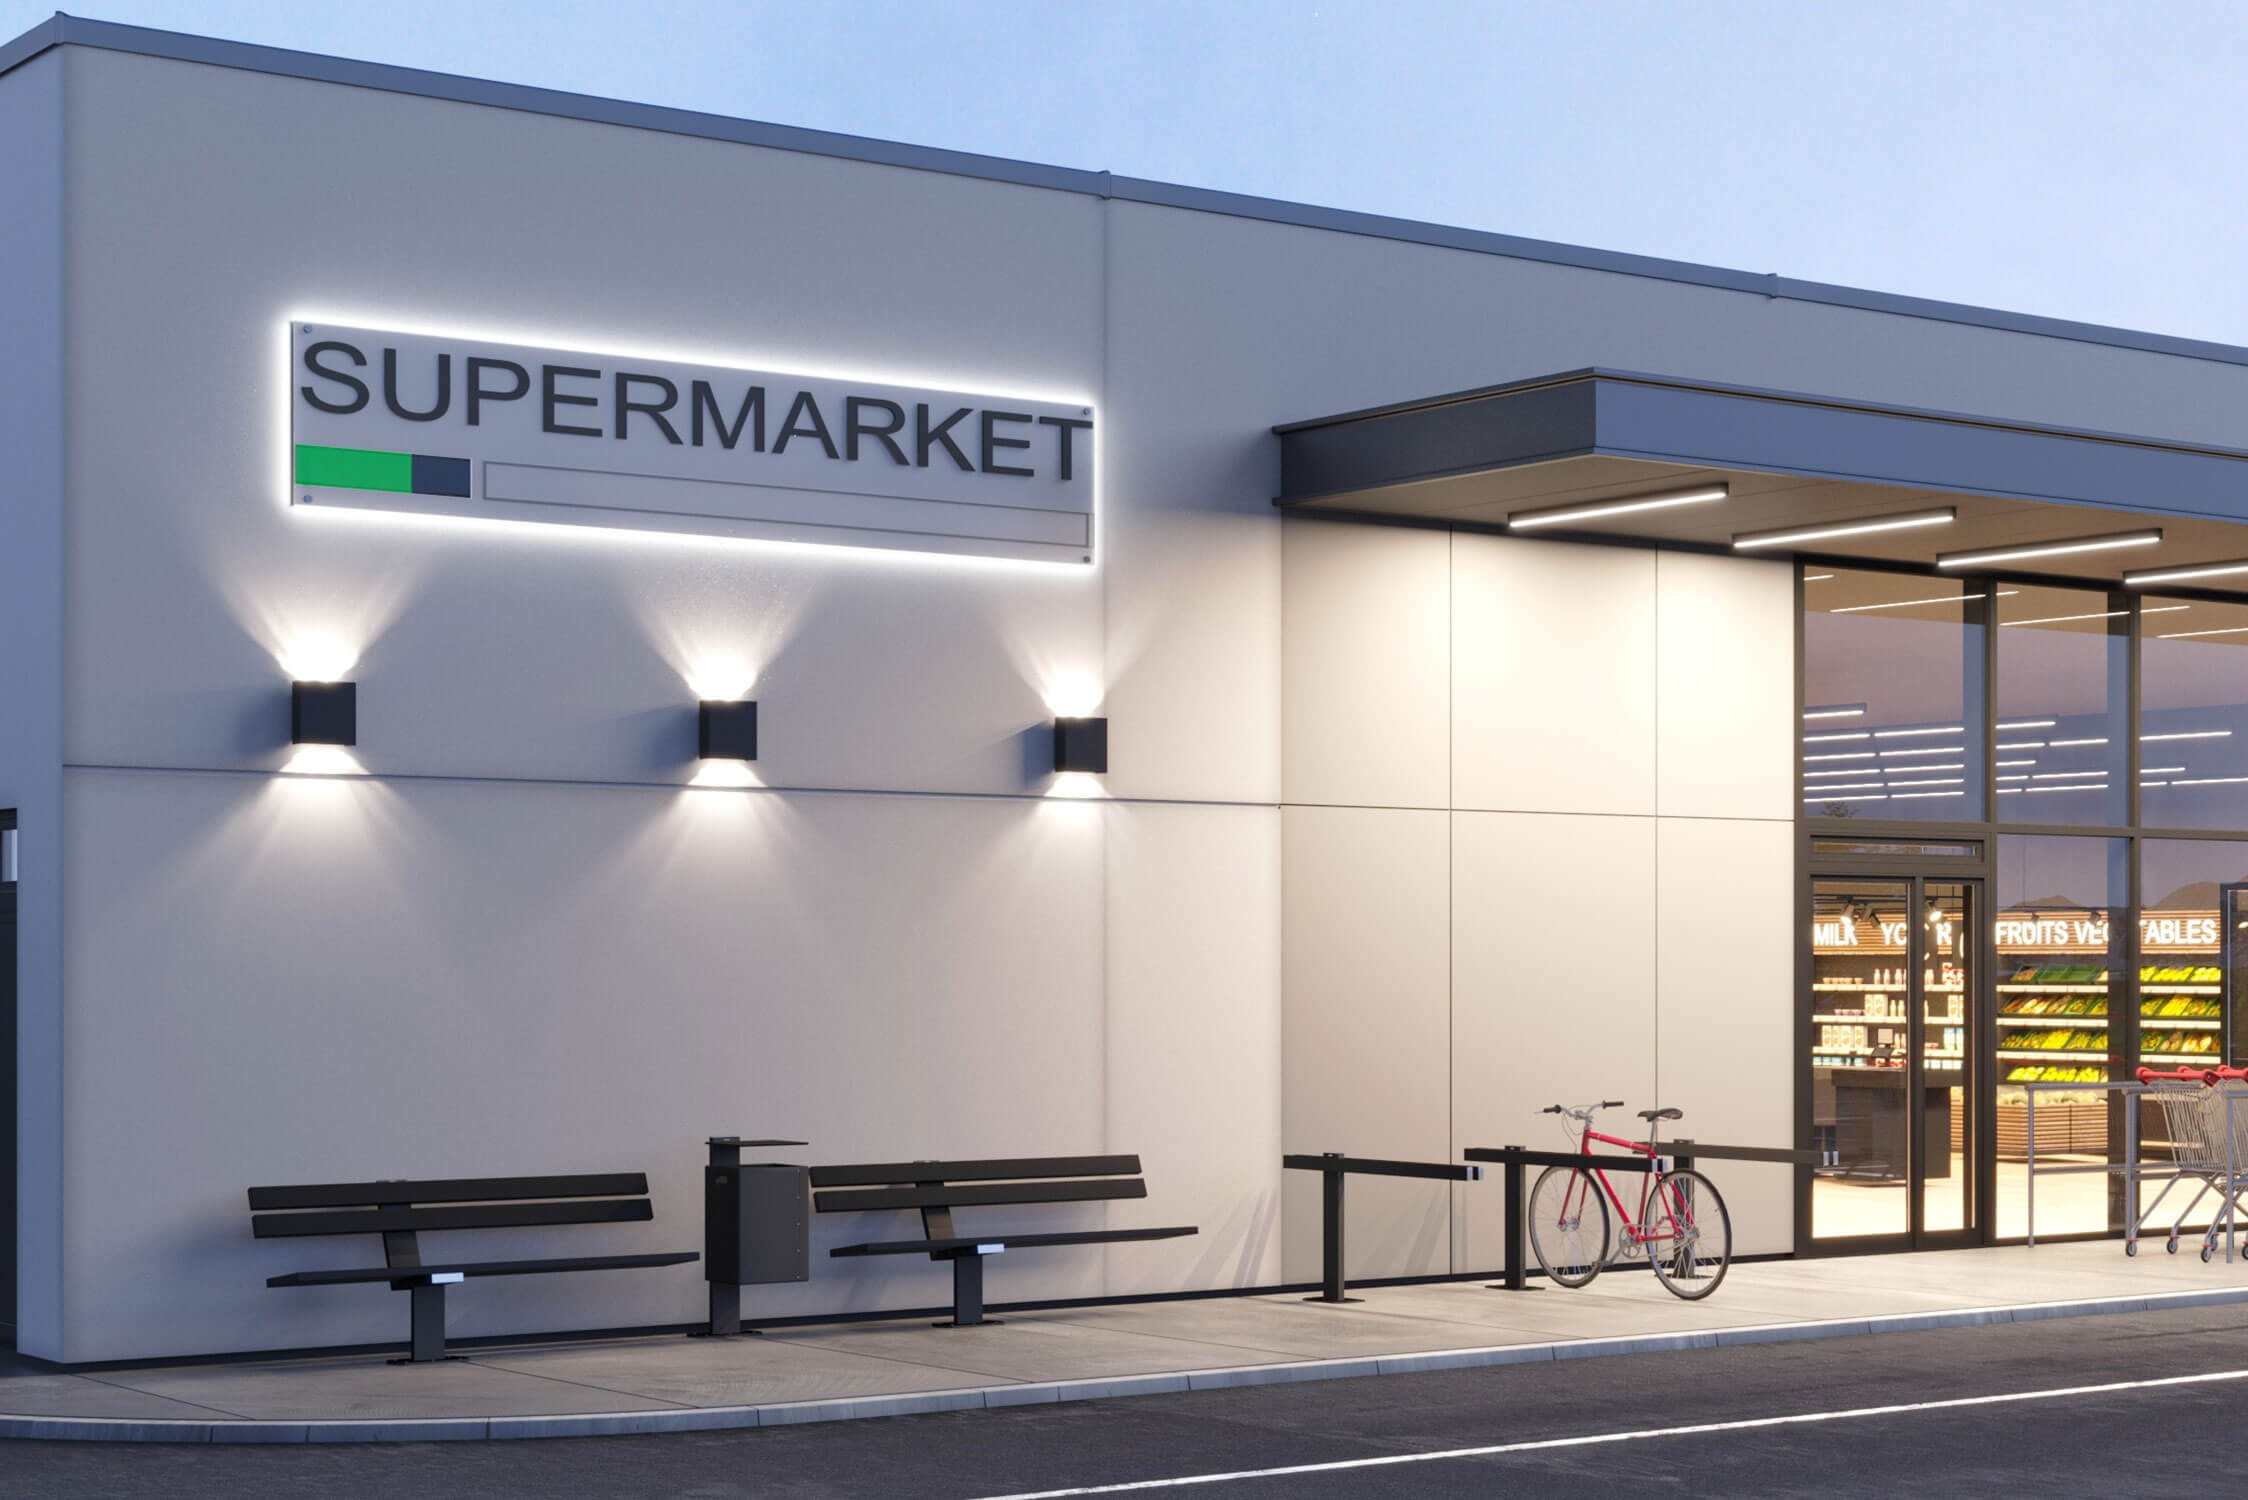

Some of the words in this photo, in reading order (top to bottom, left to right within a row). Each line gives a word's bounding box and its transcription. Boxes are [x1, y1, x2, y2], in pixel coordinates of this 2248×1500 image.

[301, 341, 1093, 482] SUPERMARKET
[1813, 922, 1858, 946] MILK
[1995, 920, 2070, 945] FRUITS
